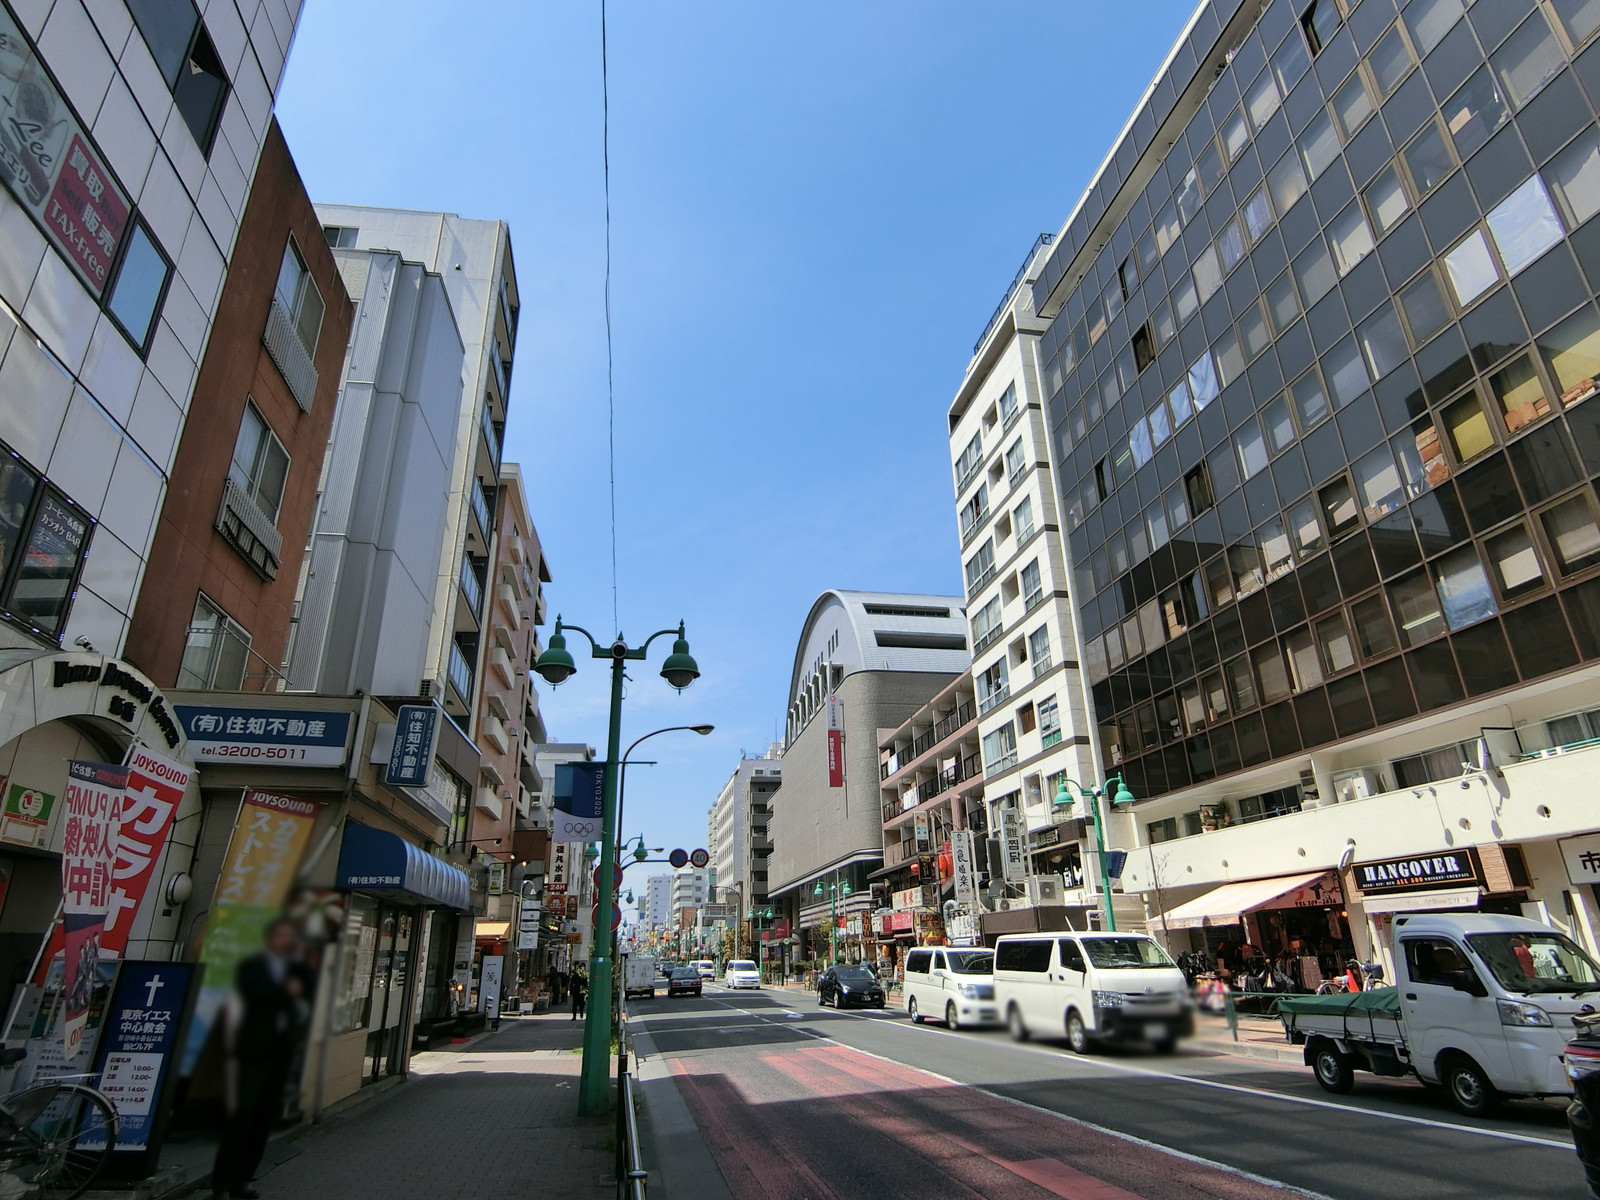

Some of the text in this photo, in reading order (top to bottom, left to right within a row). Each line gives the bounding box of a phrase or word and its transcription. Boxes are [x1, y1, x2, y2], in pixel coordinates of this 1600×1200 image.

[9, 117, 52, 167] Lee
[50, 199, 105, 280] TAX-Free
[82, 203, 116, 257] 販売
[65, 527, 81, 549] BAR
[190, 714, 327, 738] (有)住知不動産
[200, 745, 307, 760] tel.3200-5011
[399, 710, 426, 779] (有)住知不動産
[132, 752, 188, 785] JOYSOUND
[251, 793, 314, 815] JOYSOUND
[694, 852, 706, 864] 40
[1363, 856, 1459, 882] HANGOVER
[347, 876, 401, 885] (有)住知不動産
[1396, 878, 1410, 886] ALL
[120, 1009, 171, 1021] 東京イエス
[120, 1021, 167, 1034] 中心教会
